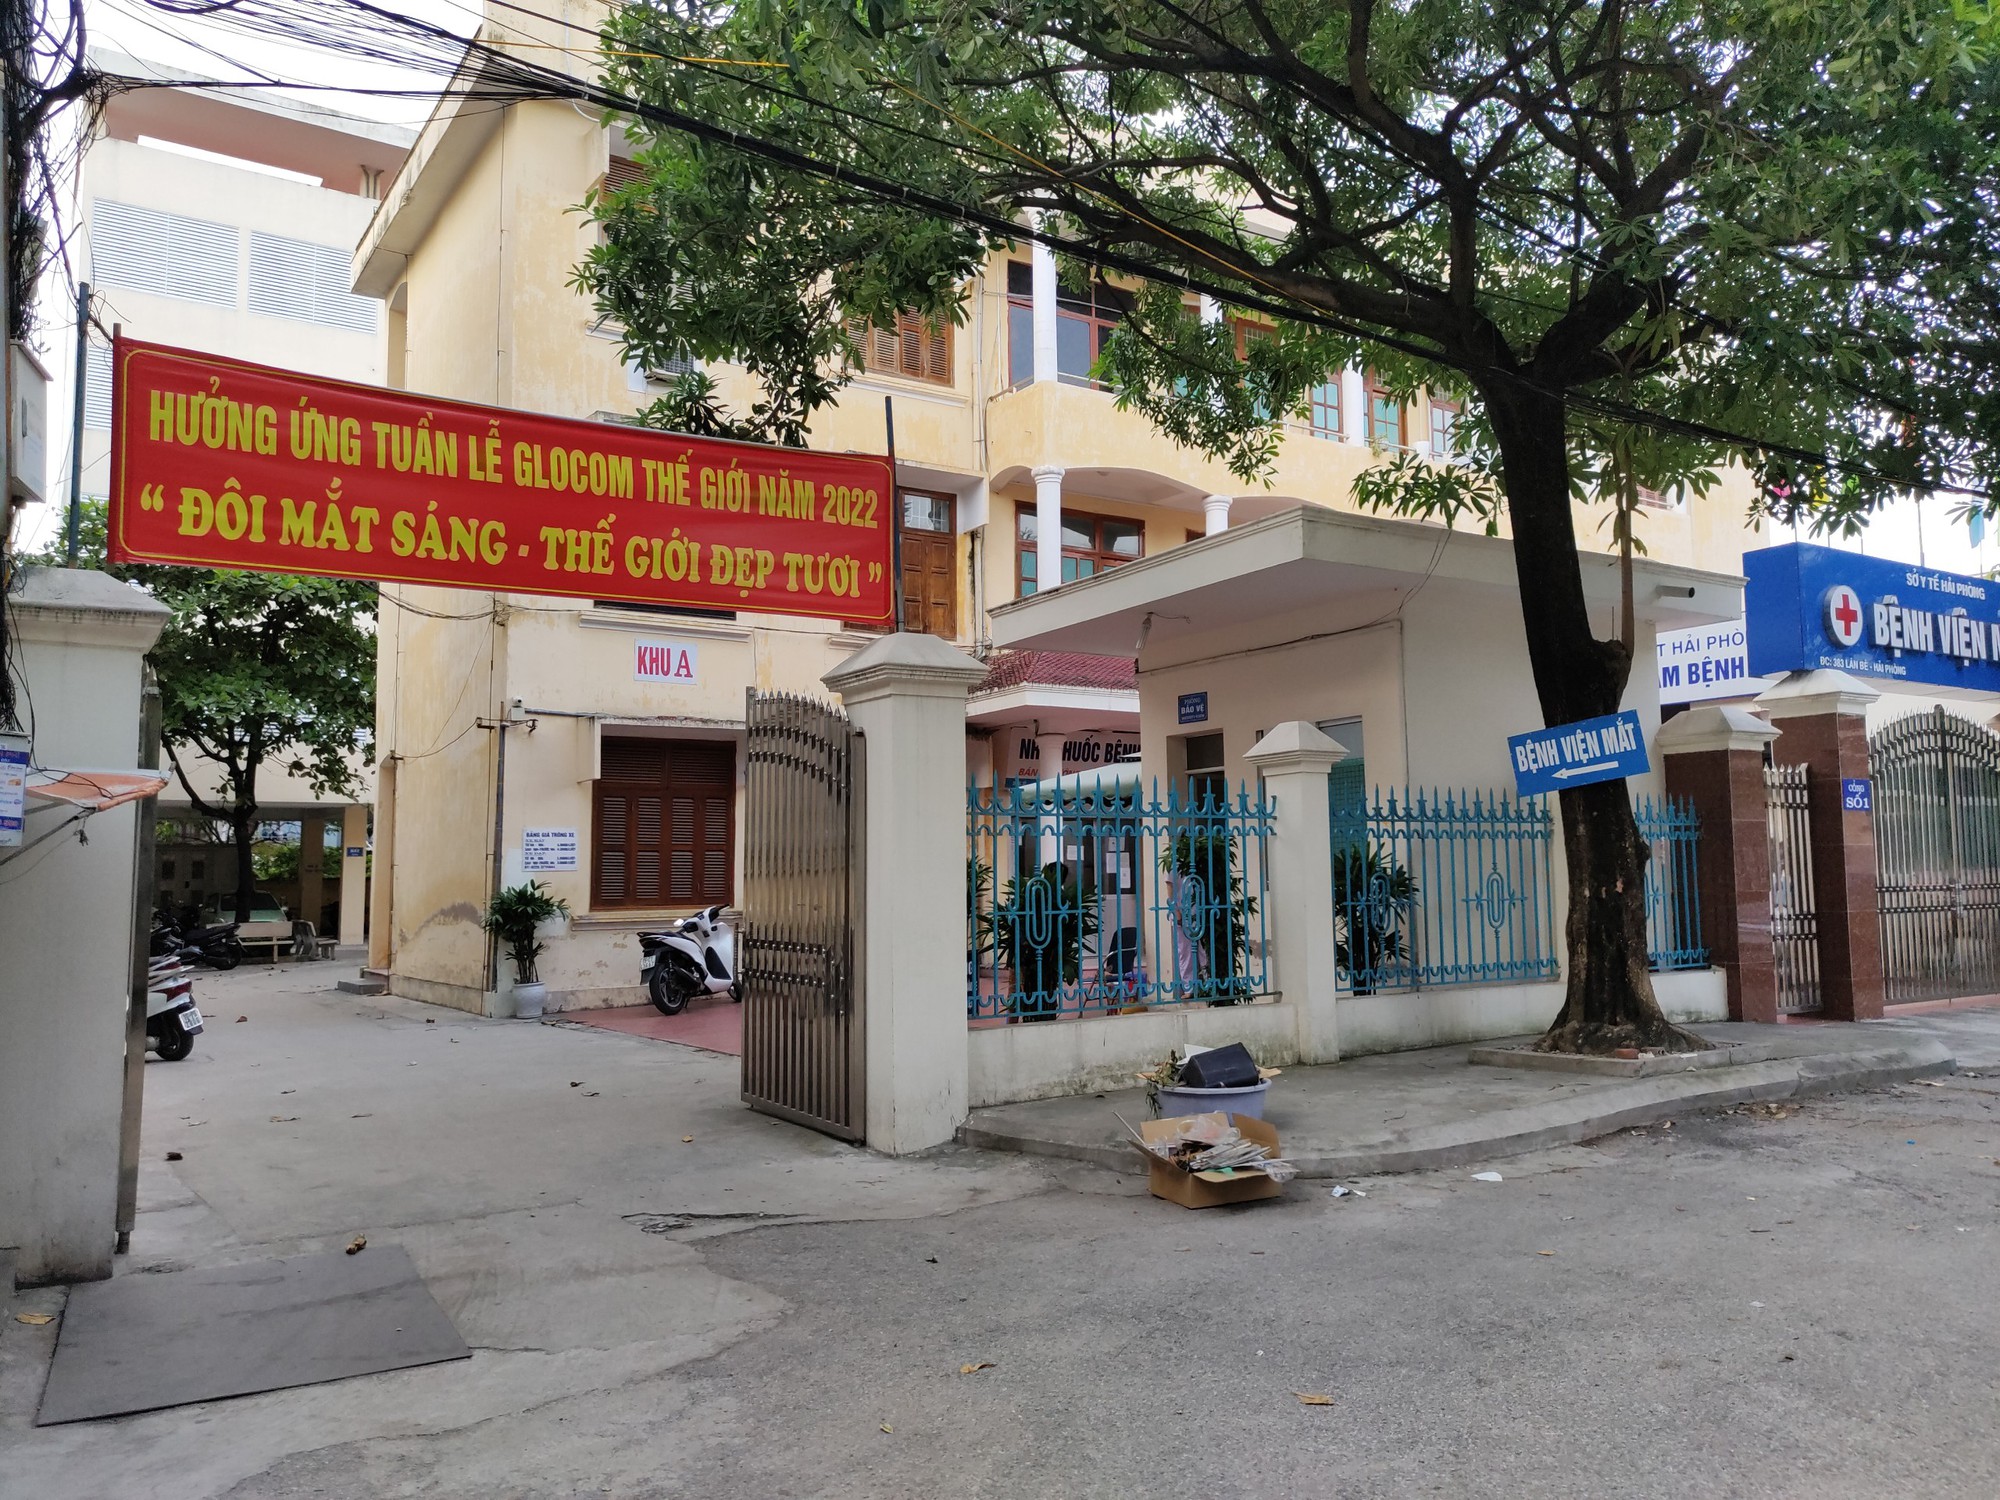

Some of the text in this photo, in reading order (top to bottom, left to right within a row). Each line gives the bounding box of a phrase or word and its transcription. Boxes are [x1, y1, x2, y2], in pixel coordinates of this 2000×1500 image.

[150, 376, 878, 529] HƯỞNG ỨNG TUẦN LỄ GLOCOM THẾ GIỚI NĂM 2022
[279, 477, 380, 553] MẮT
[391, 500, 508, 565] SÁNG
[540, 513, 616, 575] THẾ
[624, 528, 701, 583] GIỚI
[709, 543, 774, 598] ĐẸP
[1906, 568, 1986, 600] SỞ Y TẾ HẢI PHÒNG
[1672, 634, 1700, 655] HẢI
[1707, 628, 1745, 650] PHÒ
[1873, 595, 1934, 658] BỆNH
[1937, 607, 1987, 667] VIỆN
[637, 645, 693, 678] KHU A
[1687, 655, 1745, 688] BỆNH
[1833, 658, 1845, 668] 383
[1062, 735, 1101, 763] HUỐC
[1515, 717, 1637, 774] BỆNH VIỆN MẮT
